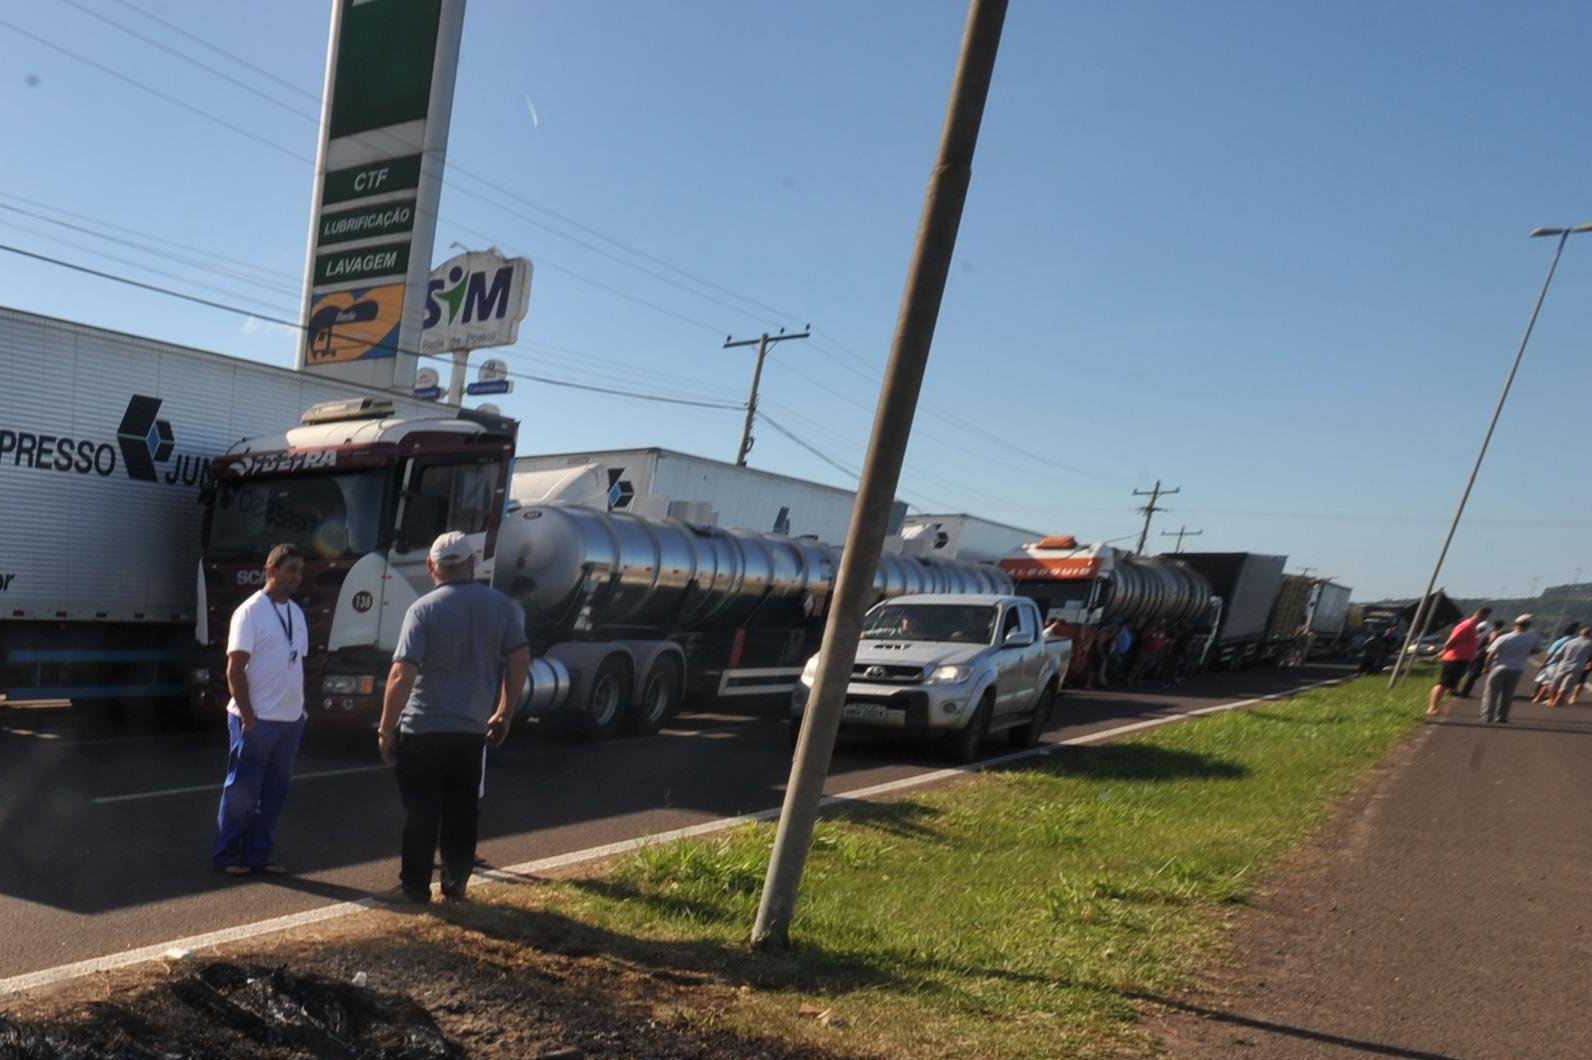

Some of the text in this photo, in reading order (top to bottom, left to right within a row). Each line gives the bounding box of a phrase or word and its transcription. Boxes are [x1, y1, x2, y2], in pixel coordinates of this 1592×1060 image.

[354, 167, 390, 192] CTF
[324, 207, 410, 236] LUBRIFICAÇÃO
[325, 251, 398, 277] LAVAGEM
[422, 266, 514, 329] SIM
[450, 336, 462, 347] de
[355, 594, 371, 609] 138
